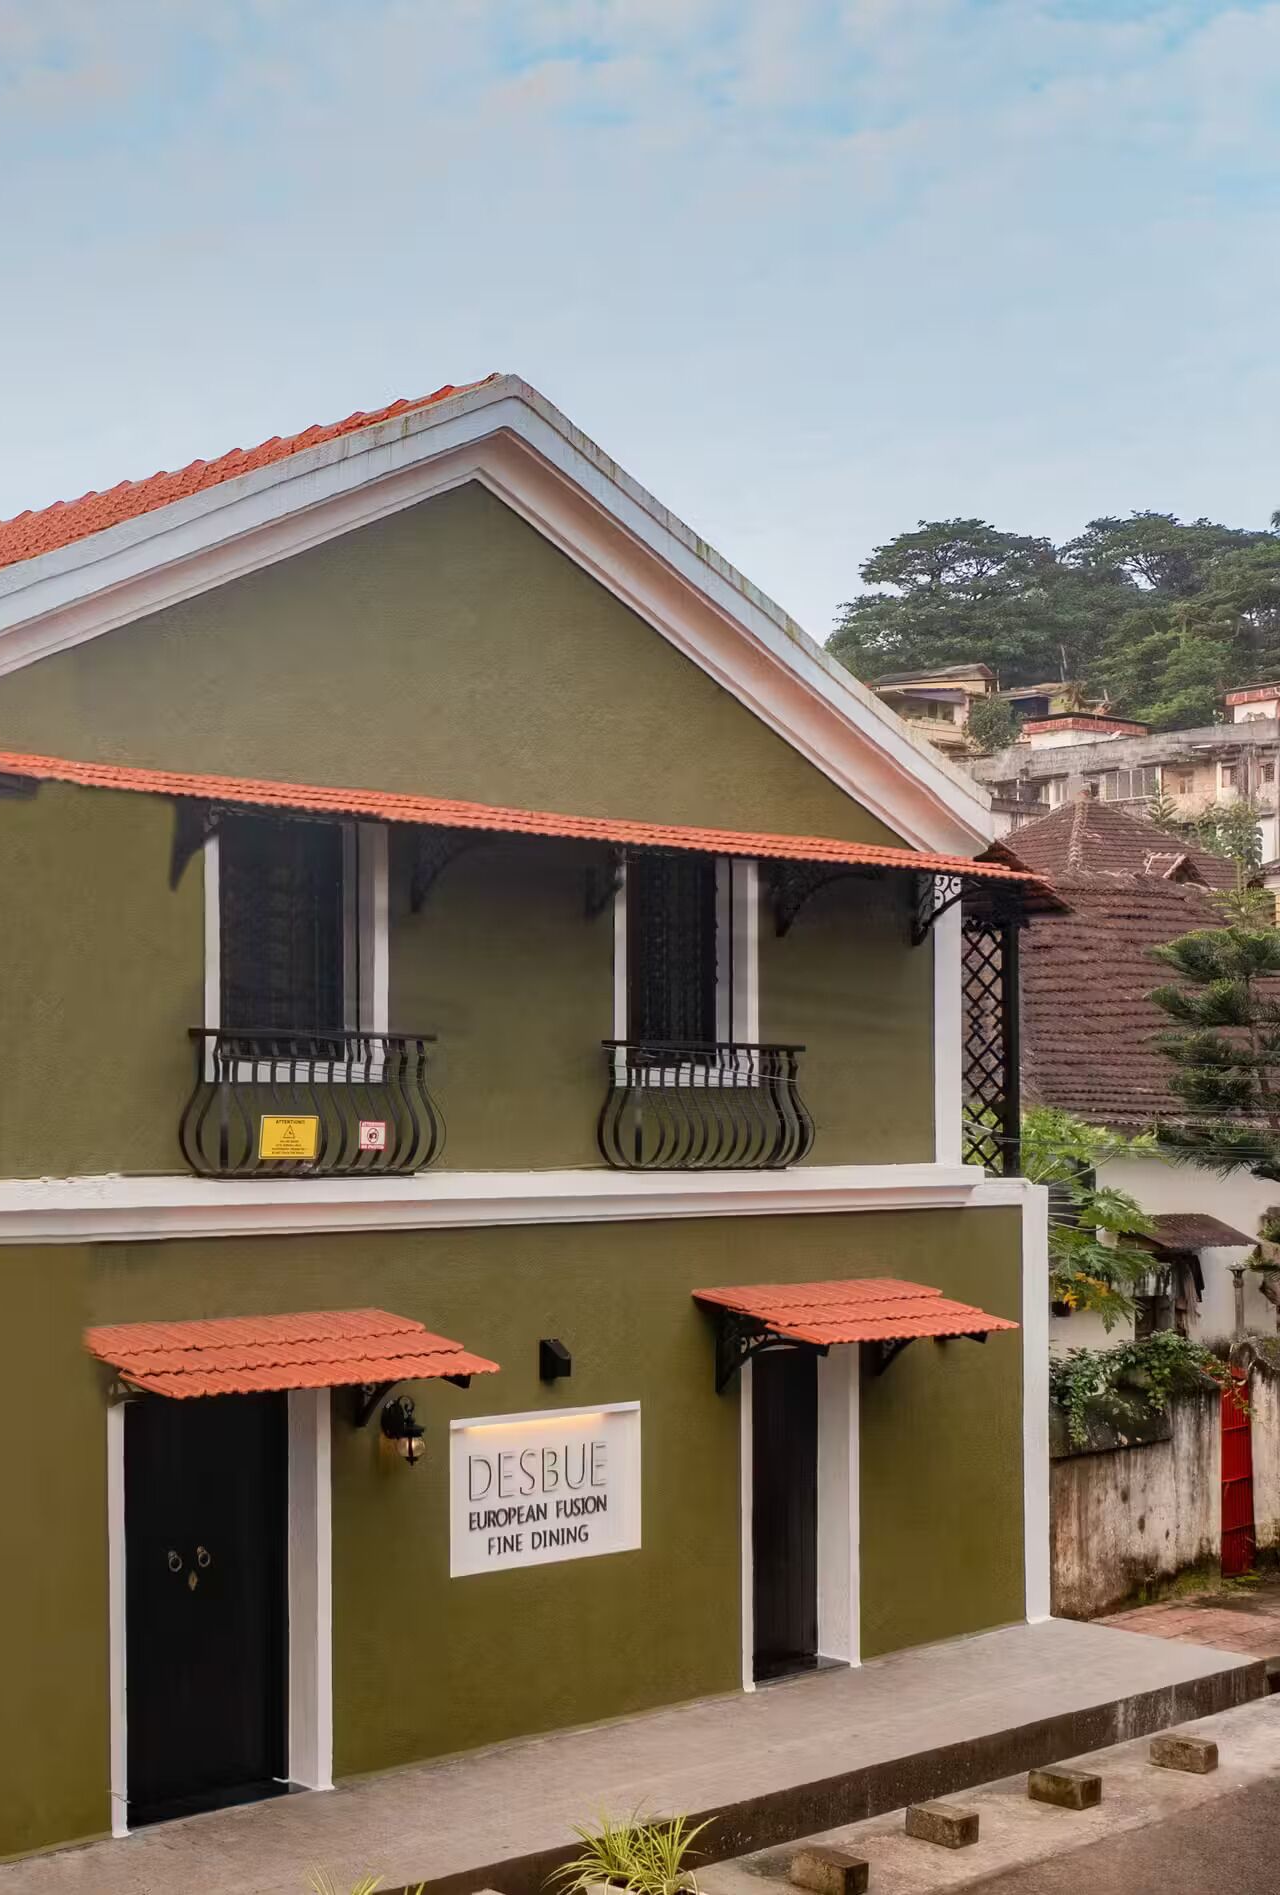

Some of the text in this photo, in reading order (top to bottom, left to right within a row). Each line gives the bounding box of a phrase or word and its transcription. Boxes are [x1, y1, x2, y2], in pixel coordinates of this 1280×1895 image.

[468, 1440, 608, 1502] DESBUE
[469, 1494, 608, 1532] EUROPEAN FUSION
[487, 1524, 590, 1556] FINE DINING
